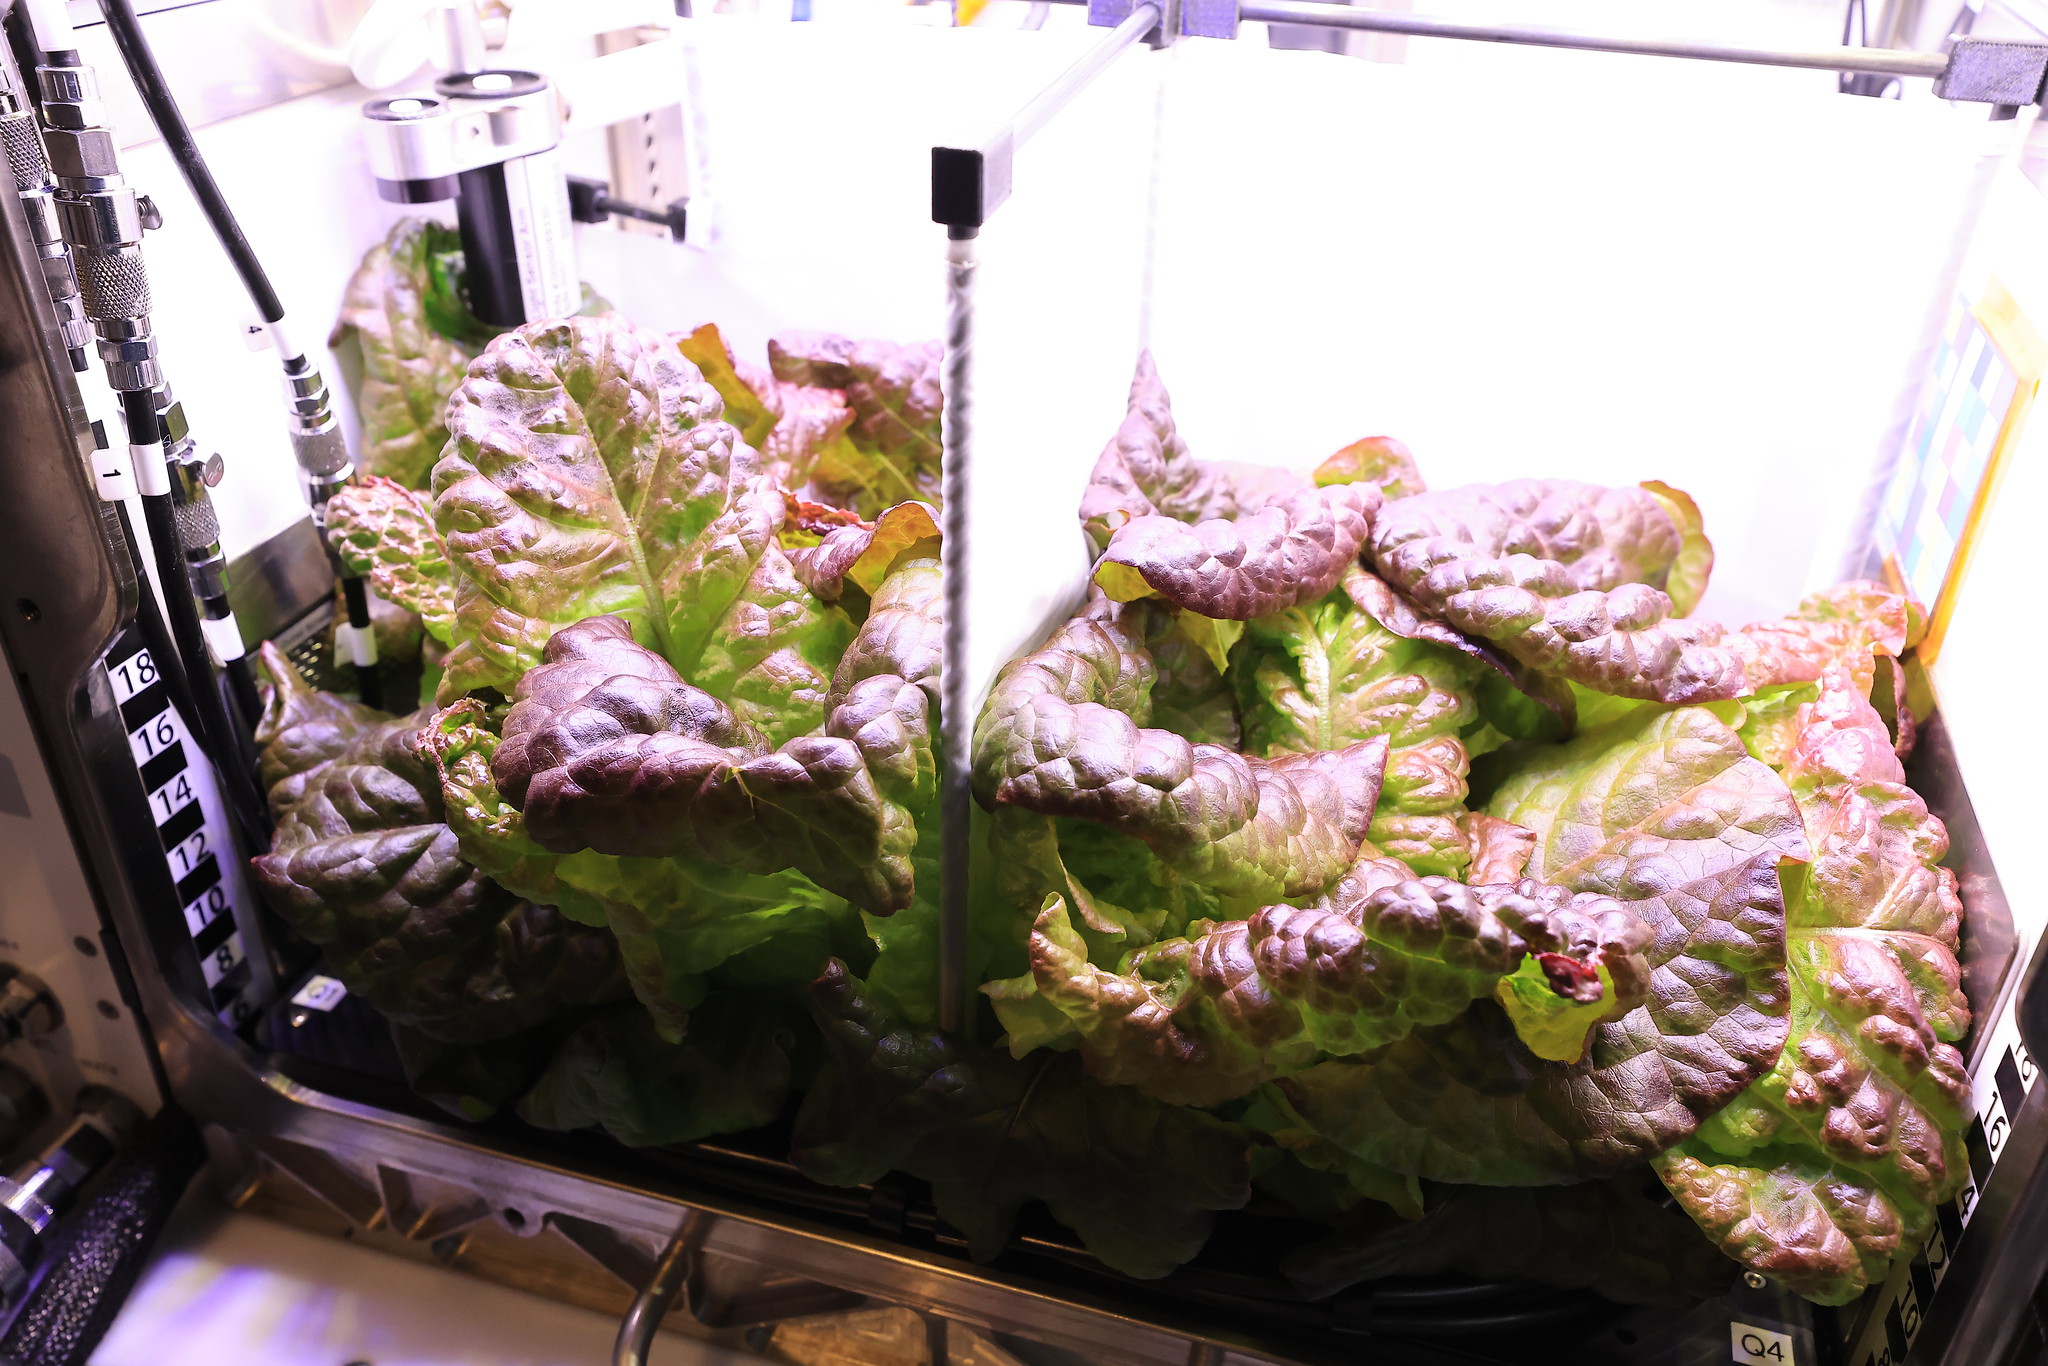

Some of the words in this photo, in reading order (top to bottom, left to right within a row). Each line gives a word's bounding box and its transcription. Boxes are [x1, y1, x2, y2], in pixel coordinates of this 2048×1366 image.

[248, 325, 263, 334] 4
[102, 468, 122, 478] 1
[118, 652, 156, 694] 18
[137, 713, 174, 756] 16
[157, 774, 192, 815] 14
[174, 831, 210, 872] 12
[192, 885, 225, 927] 10
[215, 945, 234, 974] 8
[1983, 1090, 2006, 1152] 16
[1961, 1185, 1976, 1220] 4
[1926, 1220, 1946, 1283] 12
[1900, 1279, 1919, 1339] 10
[1741, 1333, 1785, 1362] Q4
